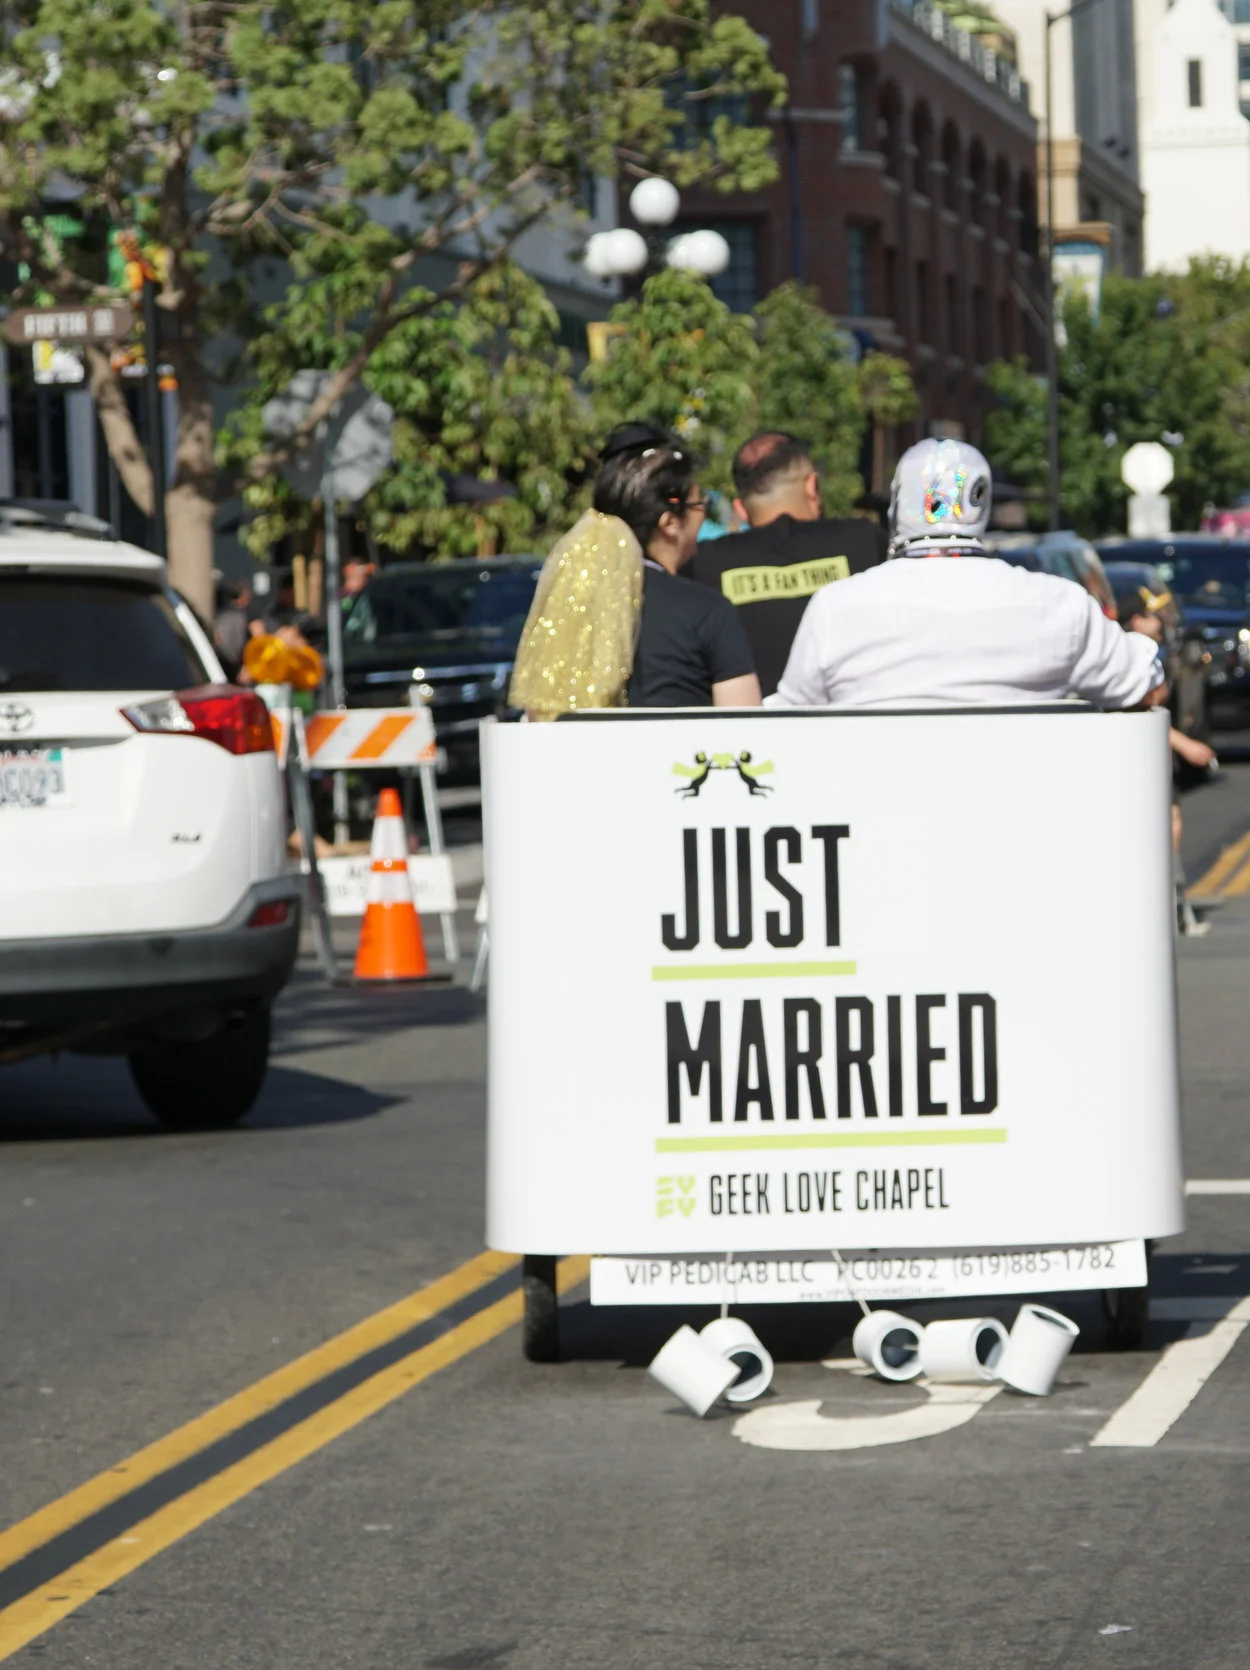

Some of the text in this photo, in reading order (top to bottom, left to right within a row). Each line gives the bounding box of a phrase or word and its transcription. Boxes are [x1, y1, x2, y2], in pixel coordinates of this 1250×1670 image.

[762, 573, 771, 592] A
[775, 573, 799, 590] FAN
[661, 823, 850, 951] JUST
[665, 993, 999, 1124] MARRIED
[710, 1168, 950, 1215] GEEK LOVE CHAPEL
[625, 1262, 662, 1286] VIP
[670, 1259, 769, 1285] PEDICAB
[777, 1258, 815, 1283] LLC
